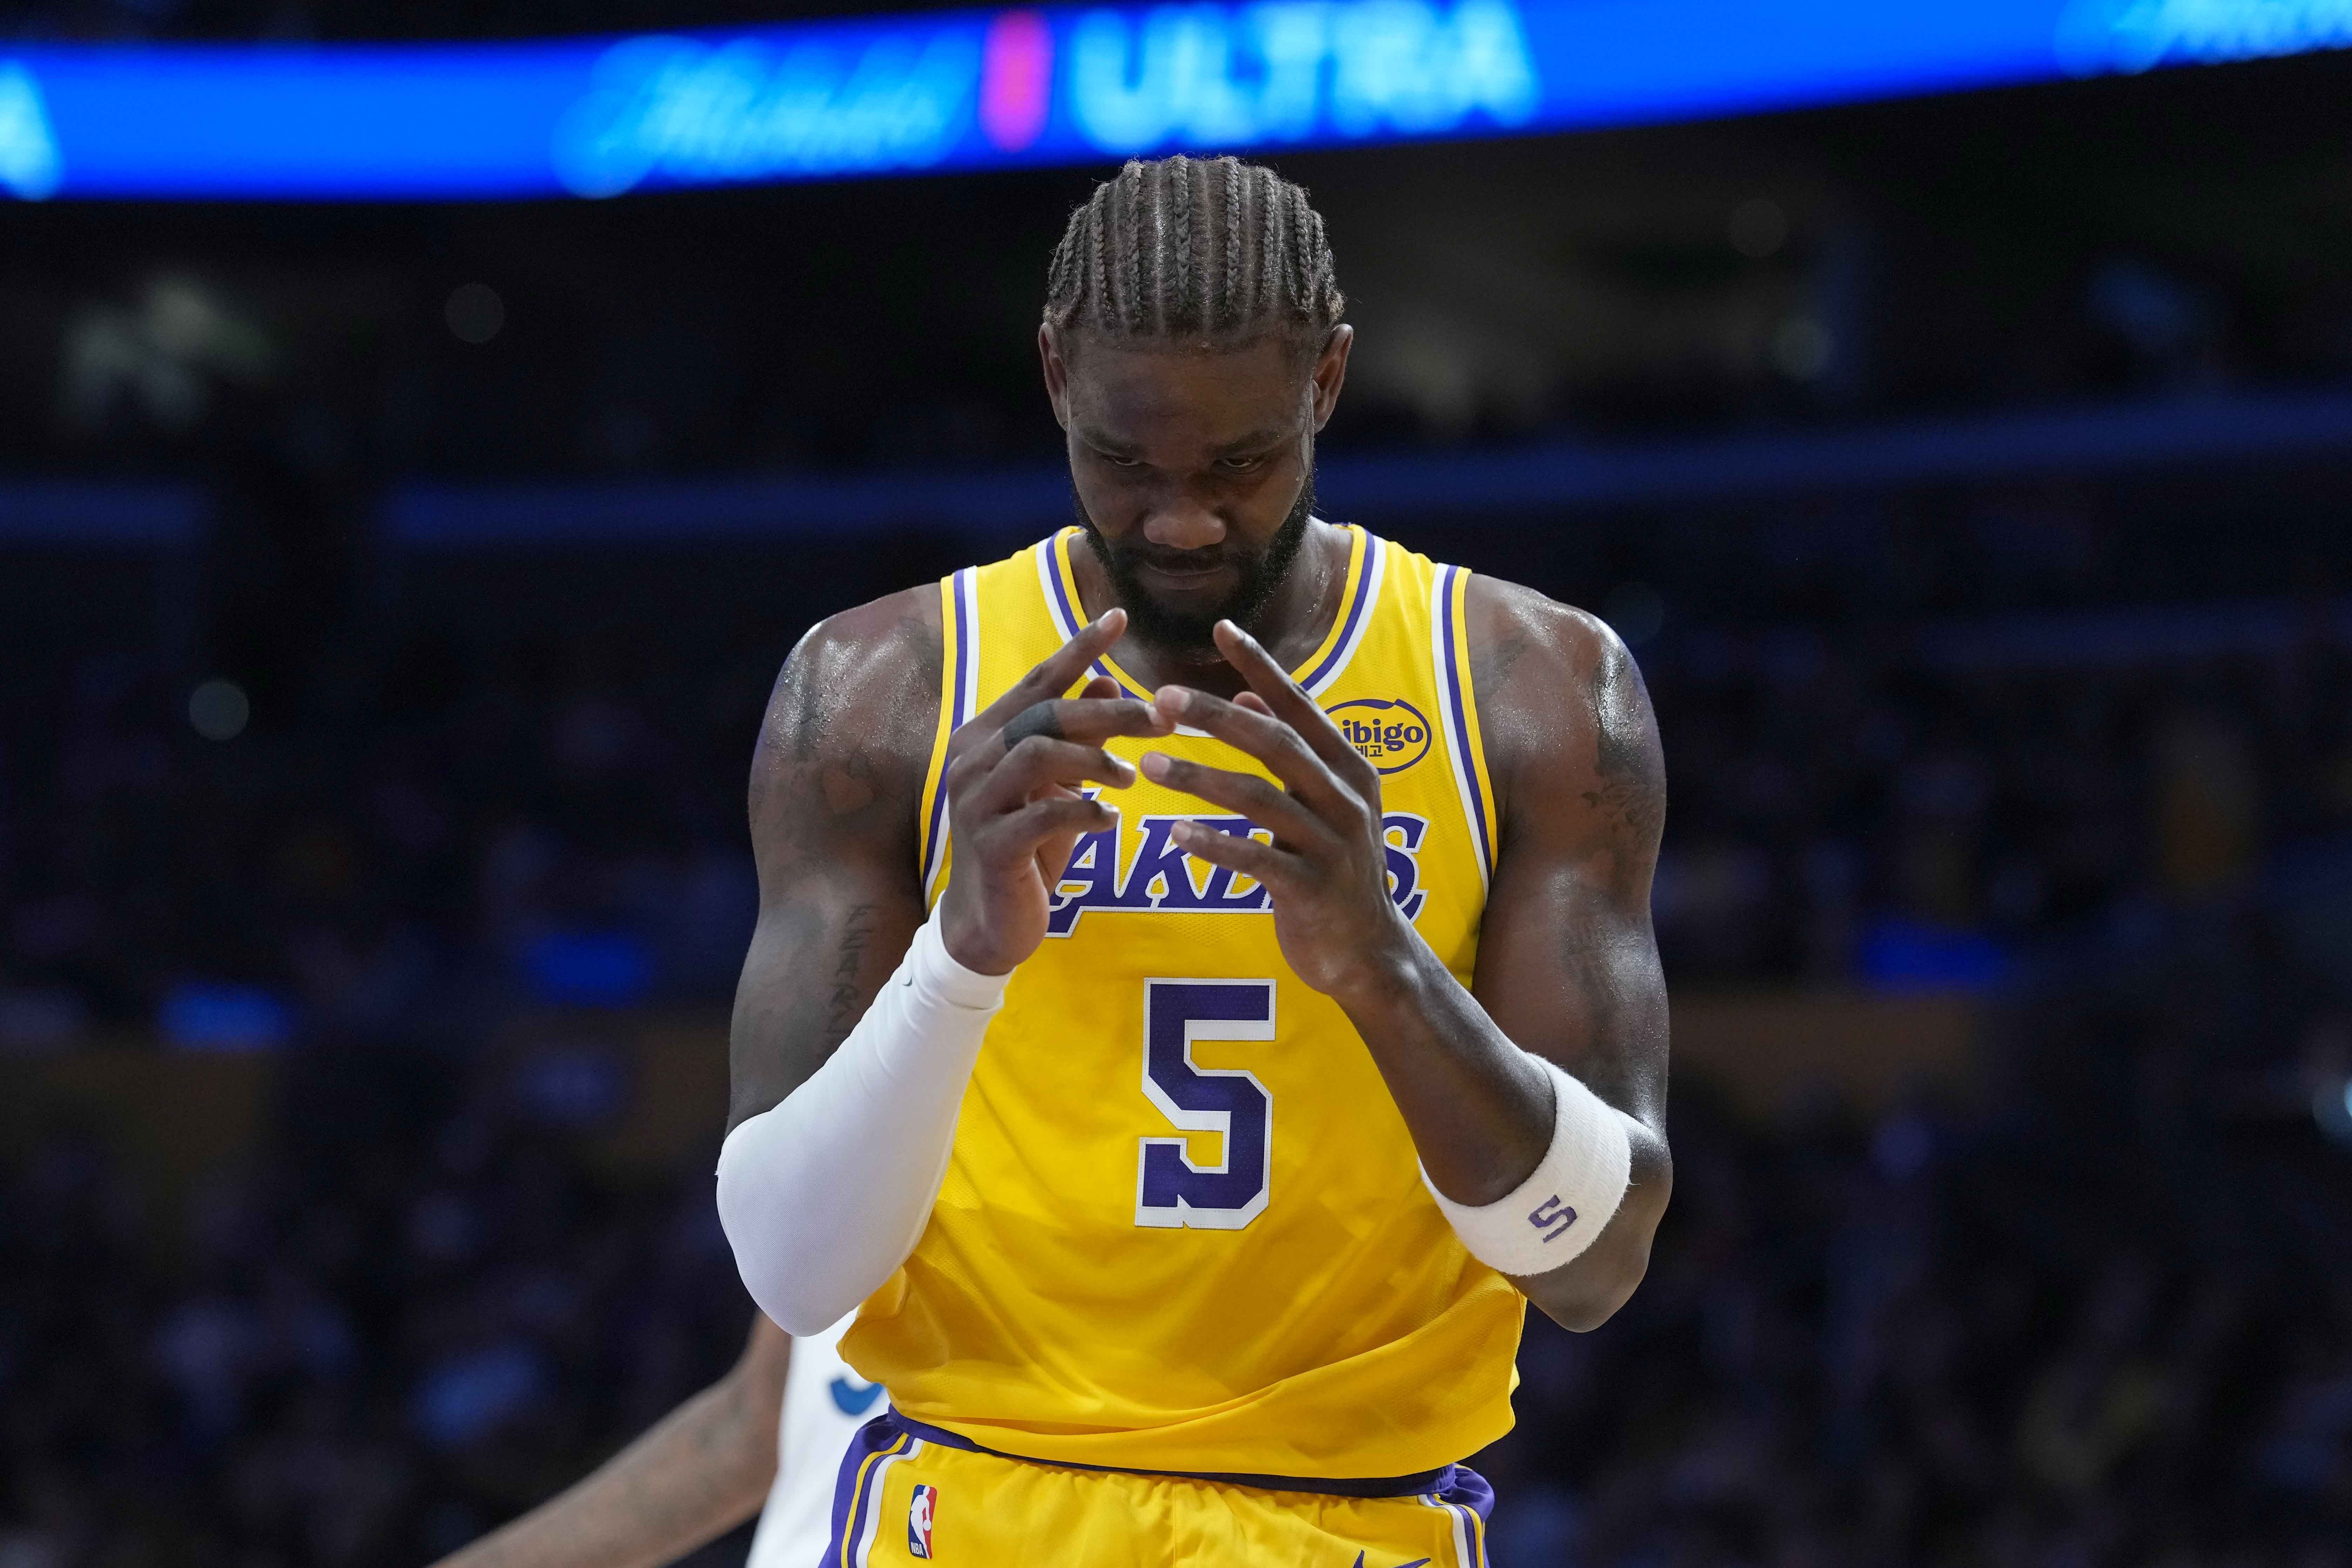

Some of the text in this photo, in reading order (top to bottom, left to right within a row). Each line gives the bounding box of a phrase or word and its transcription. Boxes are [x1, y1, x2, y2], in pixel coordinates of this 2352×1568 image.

[1342, 718, 1424, 752] ibigo
[1355, 745, 1383, 758] 비고
[1134, 977, 1276, 1230] 5
[1527, 1194, 1578, 1243] 5
[910, 1542, 924, 1556] NBA
